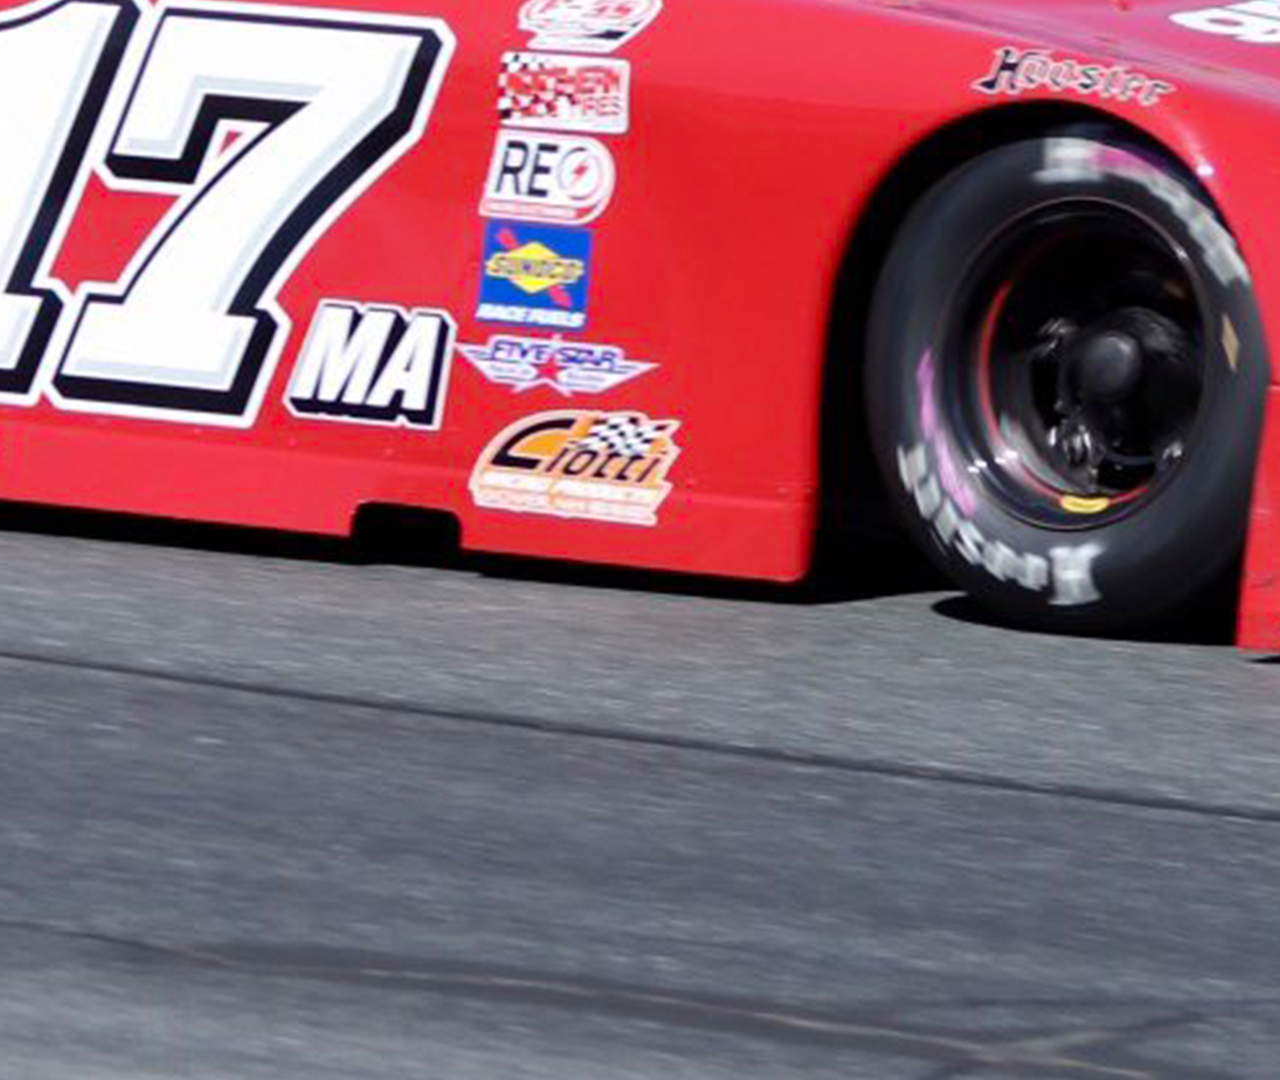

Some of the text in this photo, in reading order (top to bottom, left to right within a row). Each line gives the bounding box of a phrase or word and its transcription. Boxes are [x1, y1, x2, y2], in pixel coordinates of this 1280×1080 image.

[972, 47, 1177, 107] Hoosier
[283, 299, 458, 431] MA
[490, 339, 552, 362] FIVE
[557, 346, 620, 372] STAR
